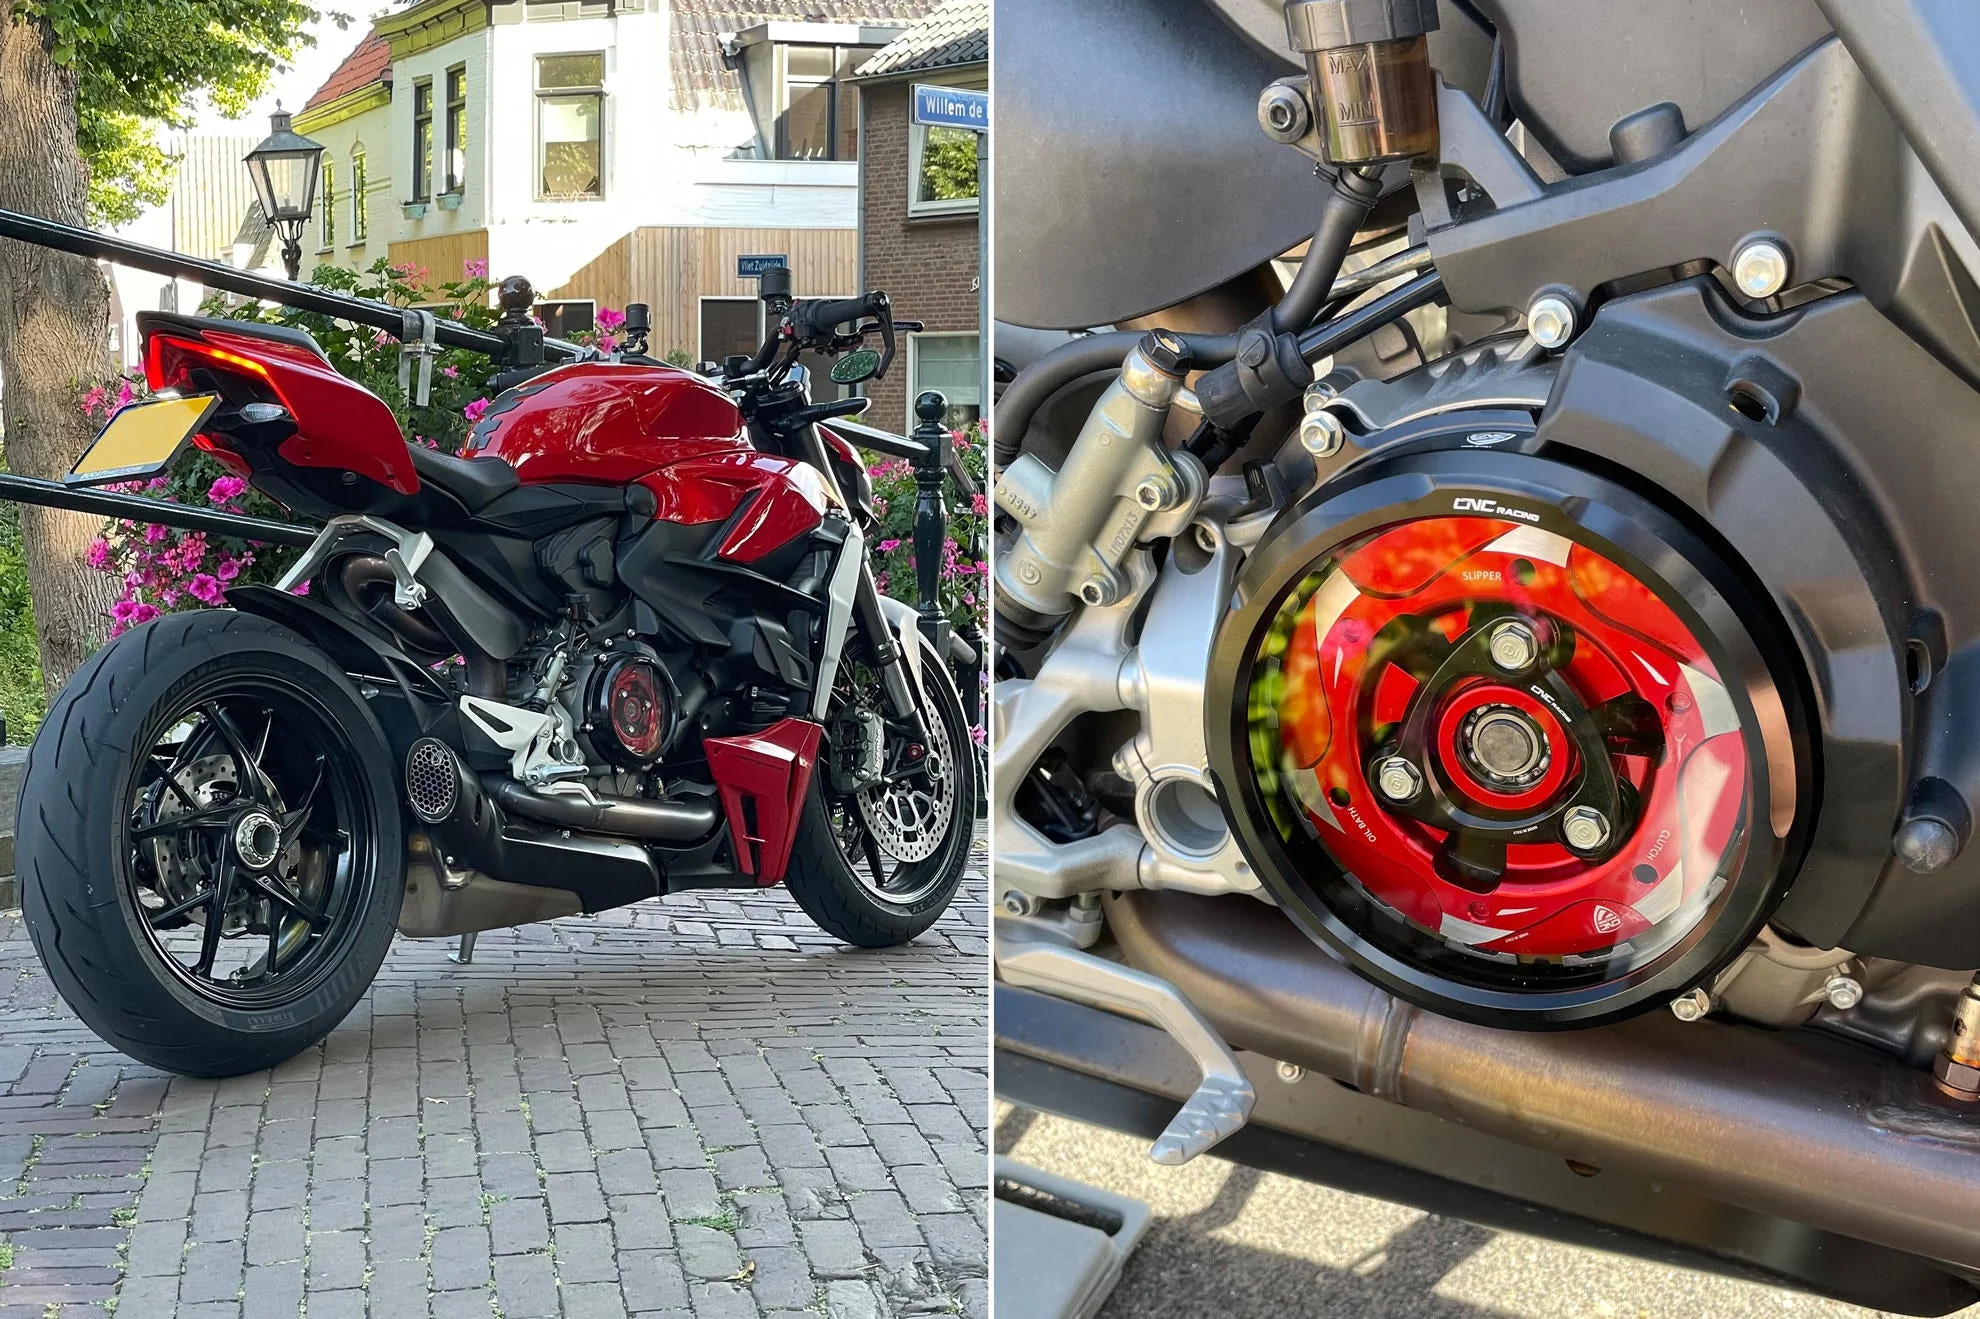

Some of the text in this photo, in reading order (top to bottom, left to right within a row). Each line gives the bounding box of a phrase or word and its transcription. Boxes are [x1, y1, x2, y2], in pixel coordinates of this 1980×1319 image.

[1329, 51, 1369, 74] MAX
[926, 95, 966, 117] Willem
[969, 101, 983, 119] de
[1340, 101, 1374, 121] MIN
[1453, 497, 1540, 522] CNC RACING
[1462, 571, 1503, 582] SLIPPER
[1530, 684, 1556, 704] CNC
[1347, 806, 1377, 843] OIL BATH
[1645, 829, 1671, 861] CLUTCH
